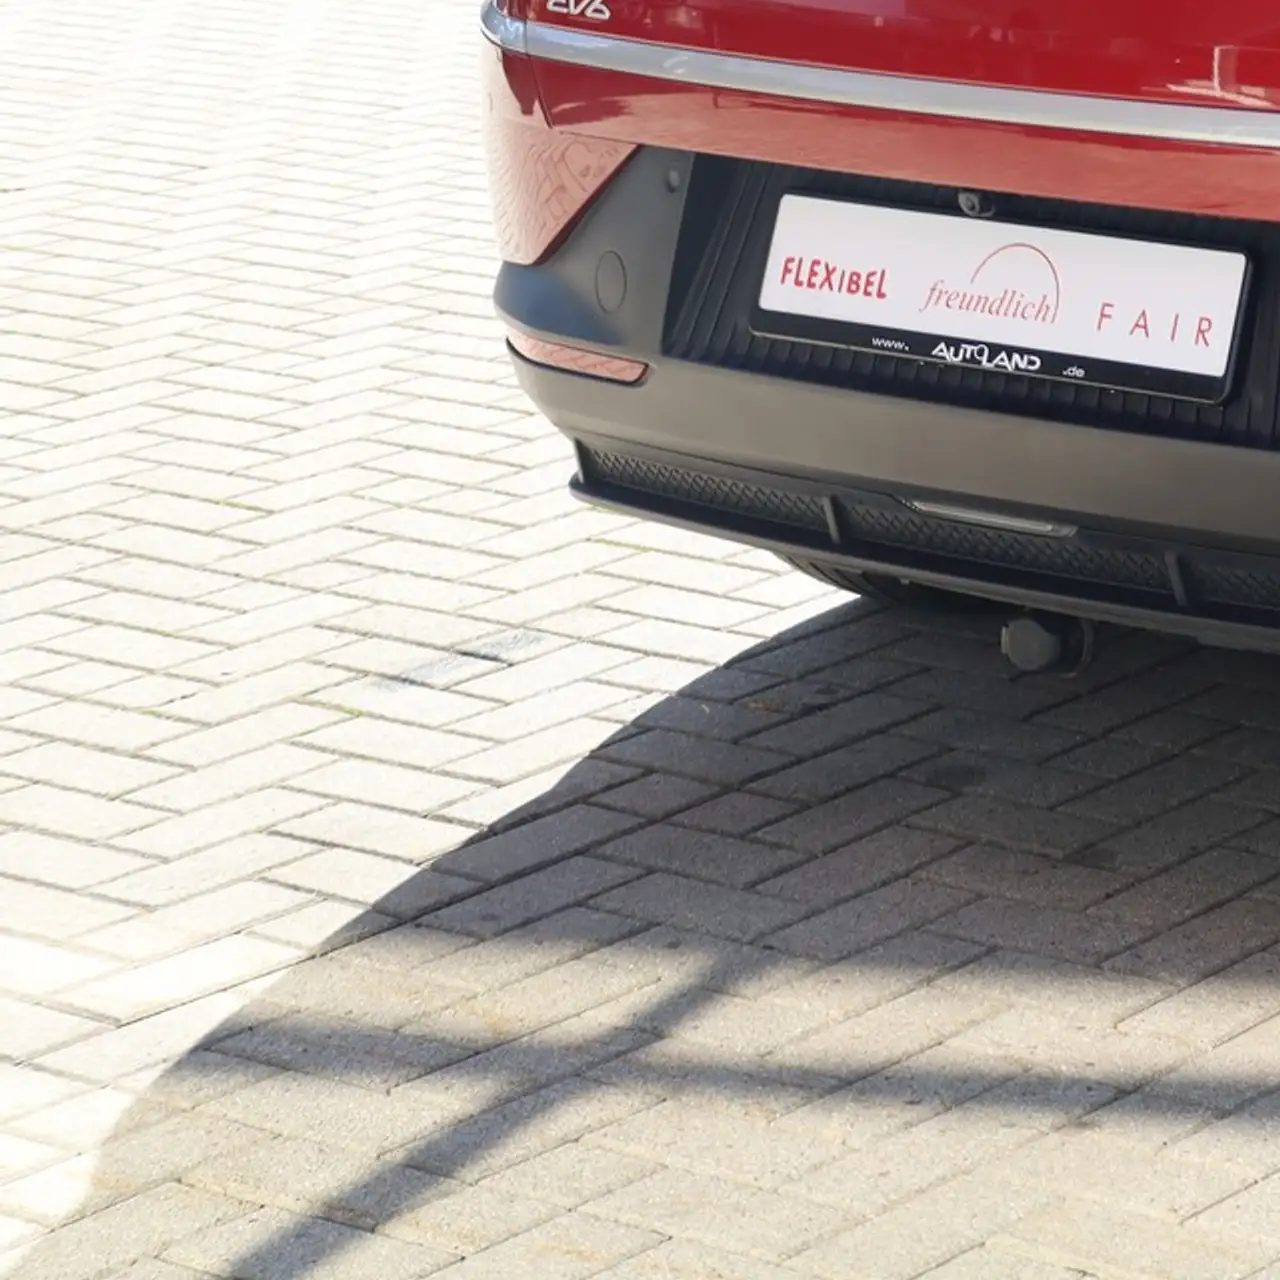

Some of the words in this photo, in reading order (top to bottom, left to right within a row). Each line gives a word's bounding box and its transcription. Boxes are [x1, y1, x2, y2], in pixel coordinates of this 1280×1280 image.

[780, 256, 888, 299] FLEXIBEL
[918, 278, 1052, 324] freundlich
[1096, 301, 1214, 348] FAIR
[871, 337, 909, 352] www.
[931, 341, 1042, 372] AUTOLAND
[1062, 365, 1086, 378] .de
